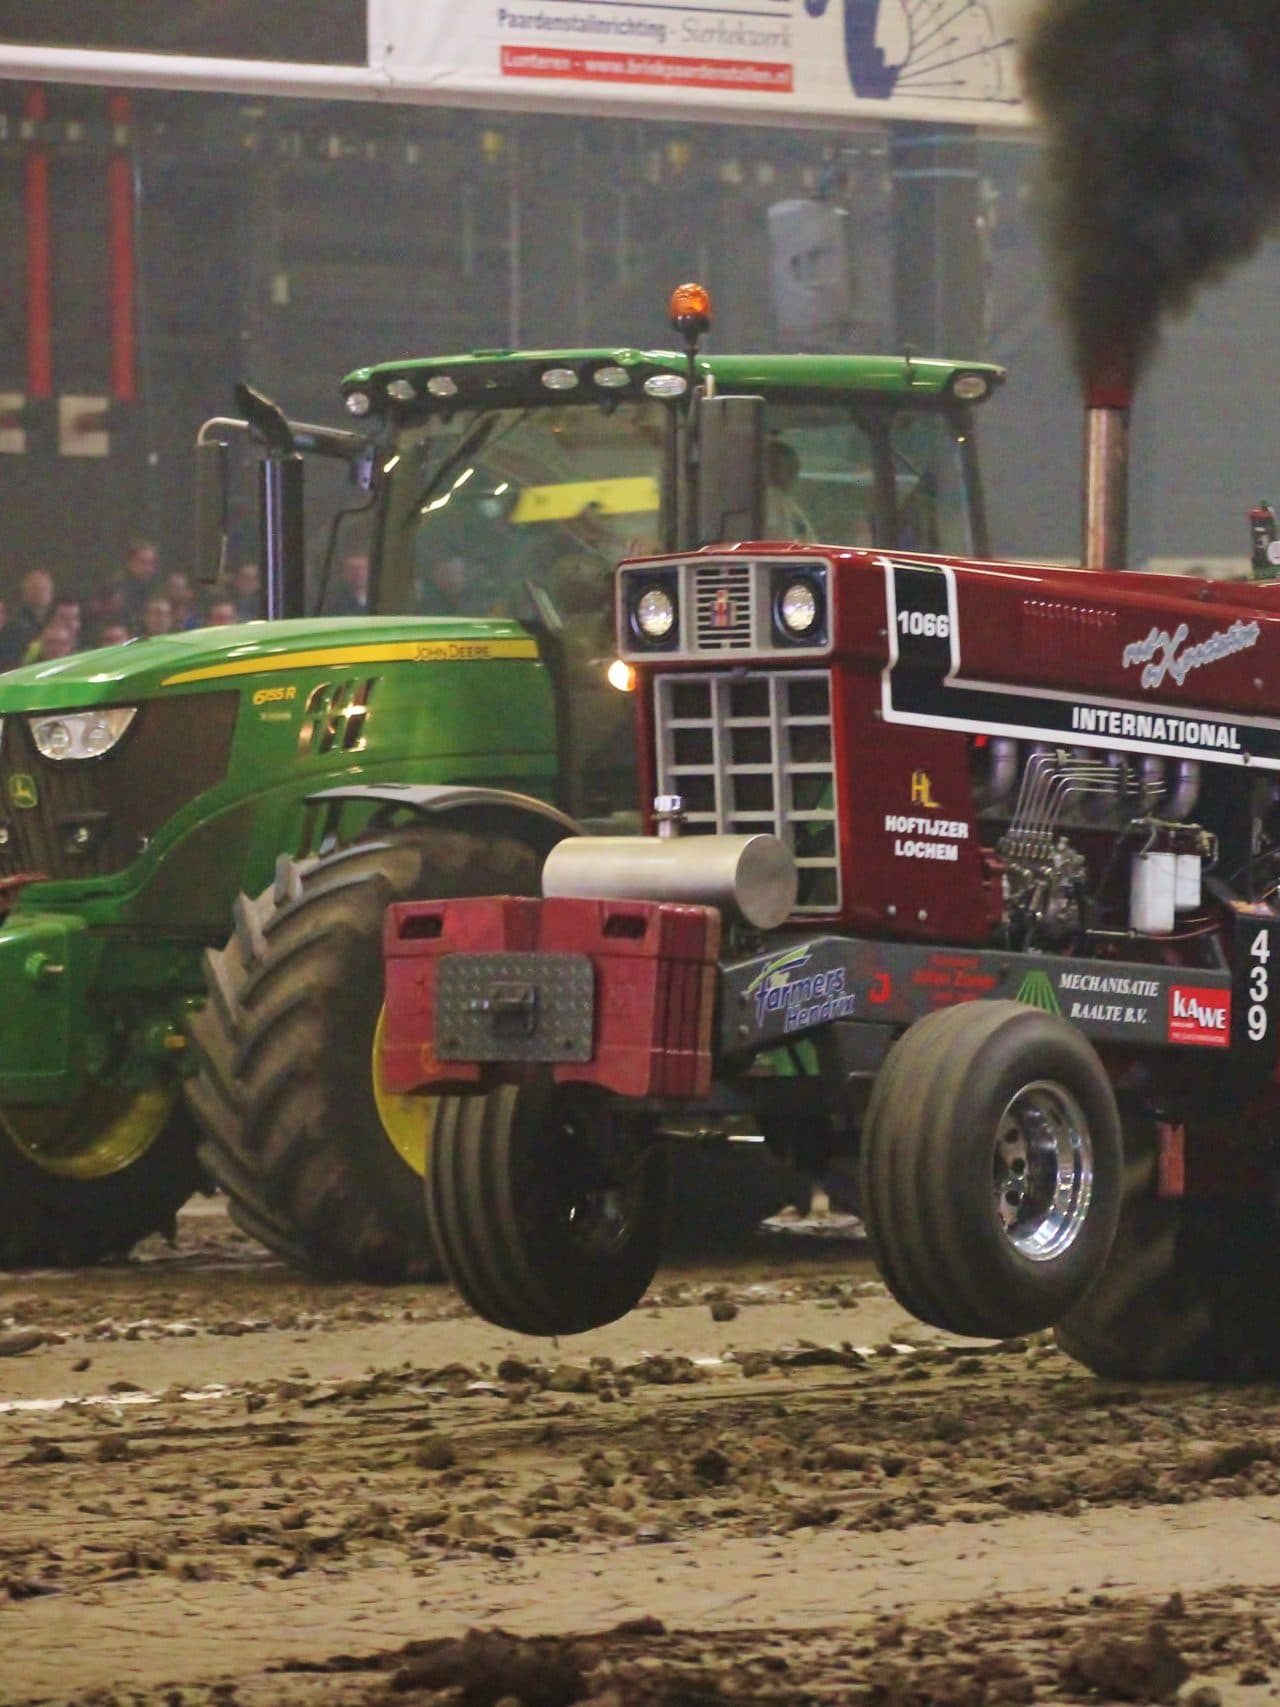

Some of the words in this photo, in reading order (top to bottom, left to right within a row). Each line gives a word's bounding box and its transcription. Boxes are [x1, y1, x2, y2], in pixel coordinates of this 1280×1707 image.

[897, 610, 950, 638] 1066
[1072, 706, 1241, 750] INTERNATIONAL
[885, 815, 969, 839] HOFTIJZER
[895, 839, 958, 861] LOCHEM
[1058, 973, 1160, 997] MECHANISATIE
[1070, 1002, 1123, 1022] RAALTE
[1124, 1007, 1147, 1024] B.V.
